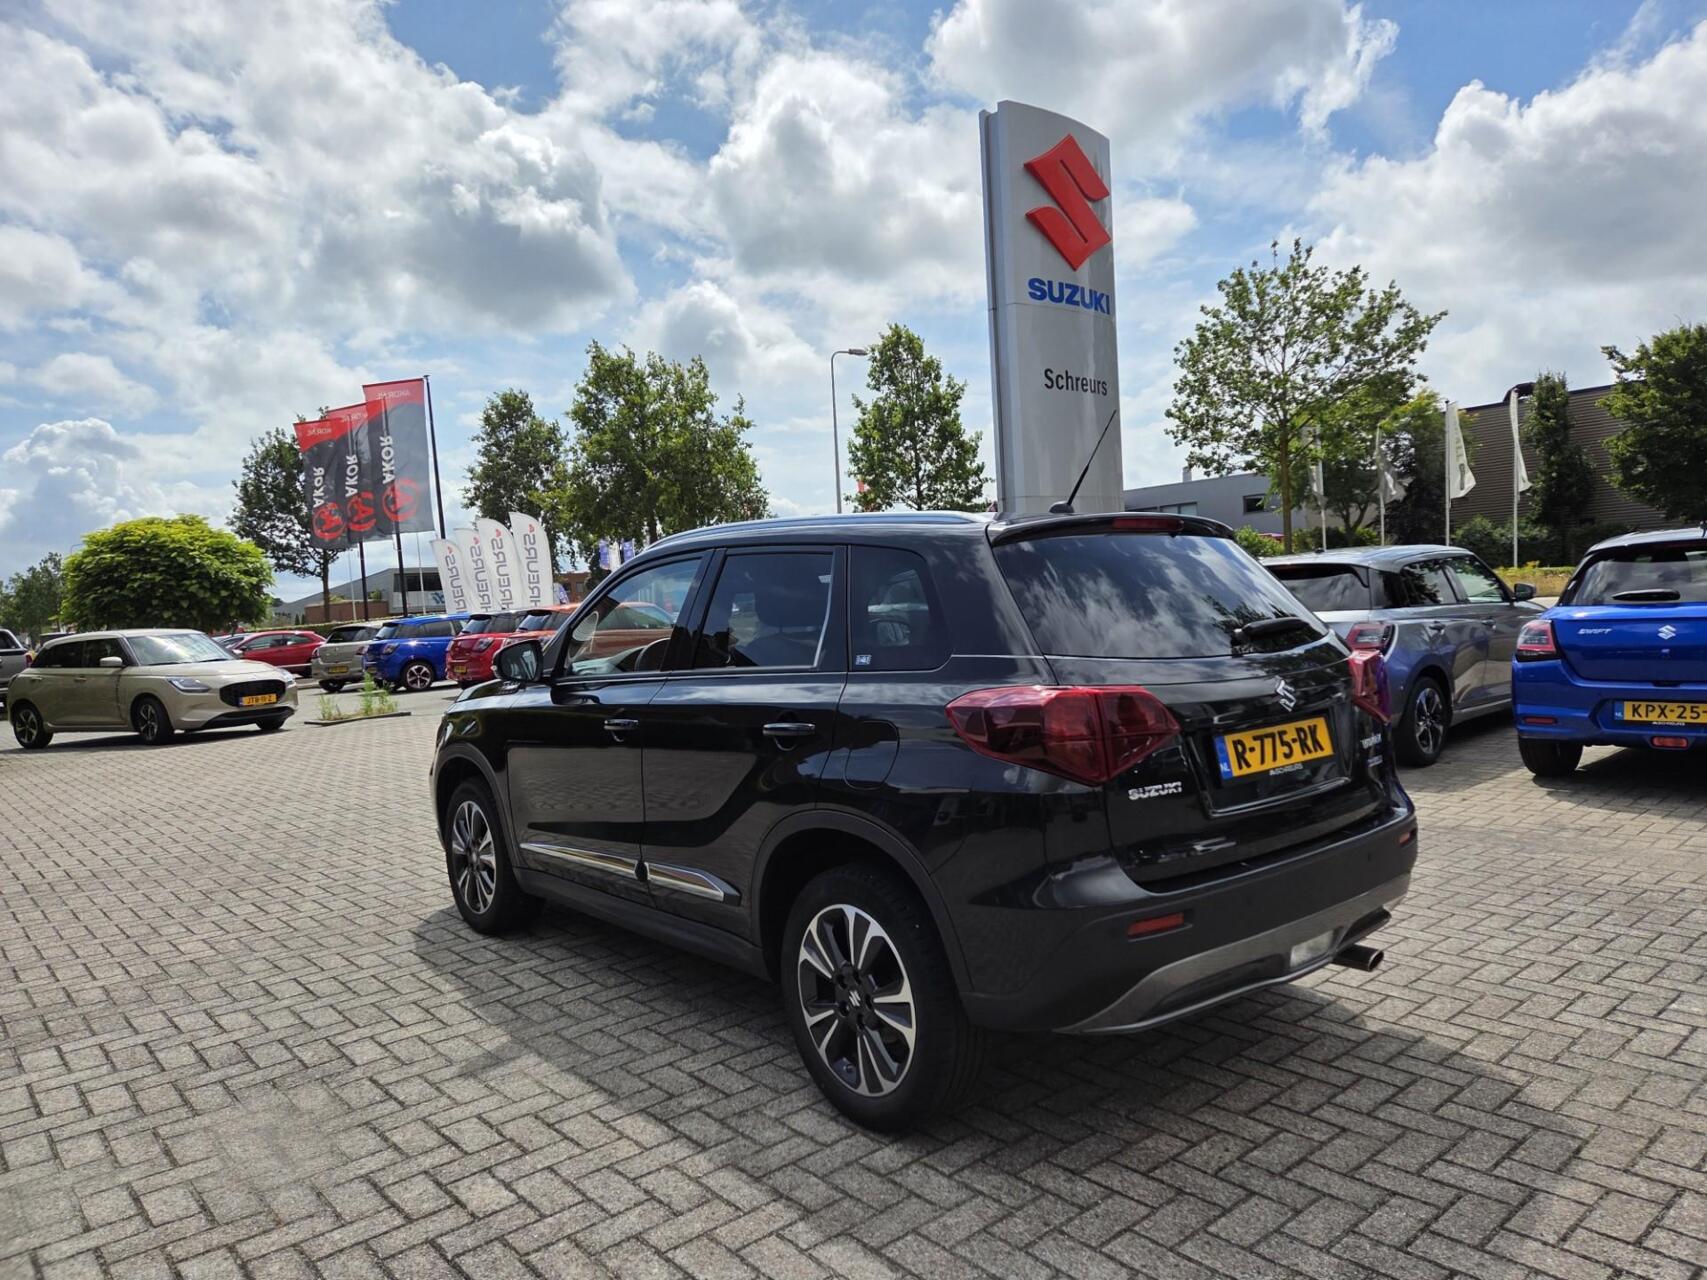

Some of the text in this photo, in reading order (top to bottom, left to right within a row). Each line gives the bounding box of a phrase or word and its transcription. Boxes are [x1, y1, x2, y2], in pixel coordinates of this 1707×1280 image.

[1028, 277, 1110, 315] SUZUKI
[1044, 368, 1108, 396] Schreurs
[1231, 724, 1325, 771] R-775-RK
[1128, 781, 1183, 800] SUZUKI
